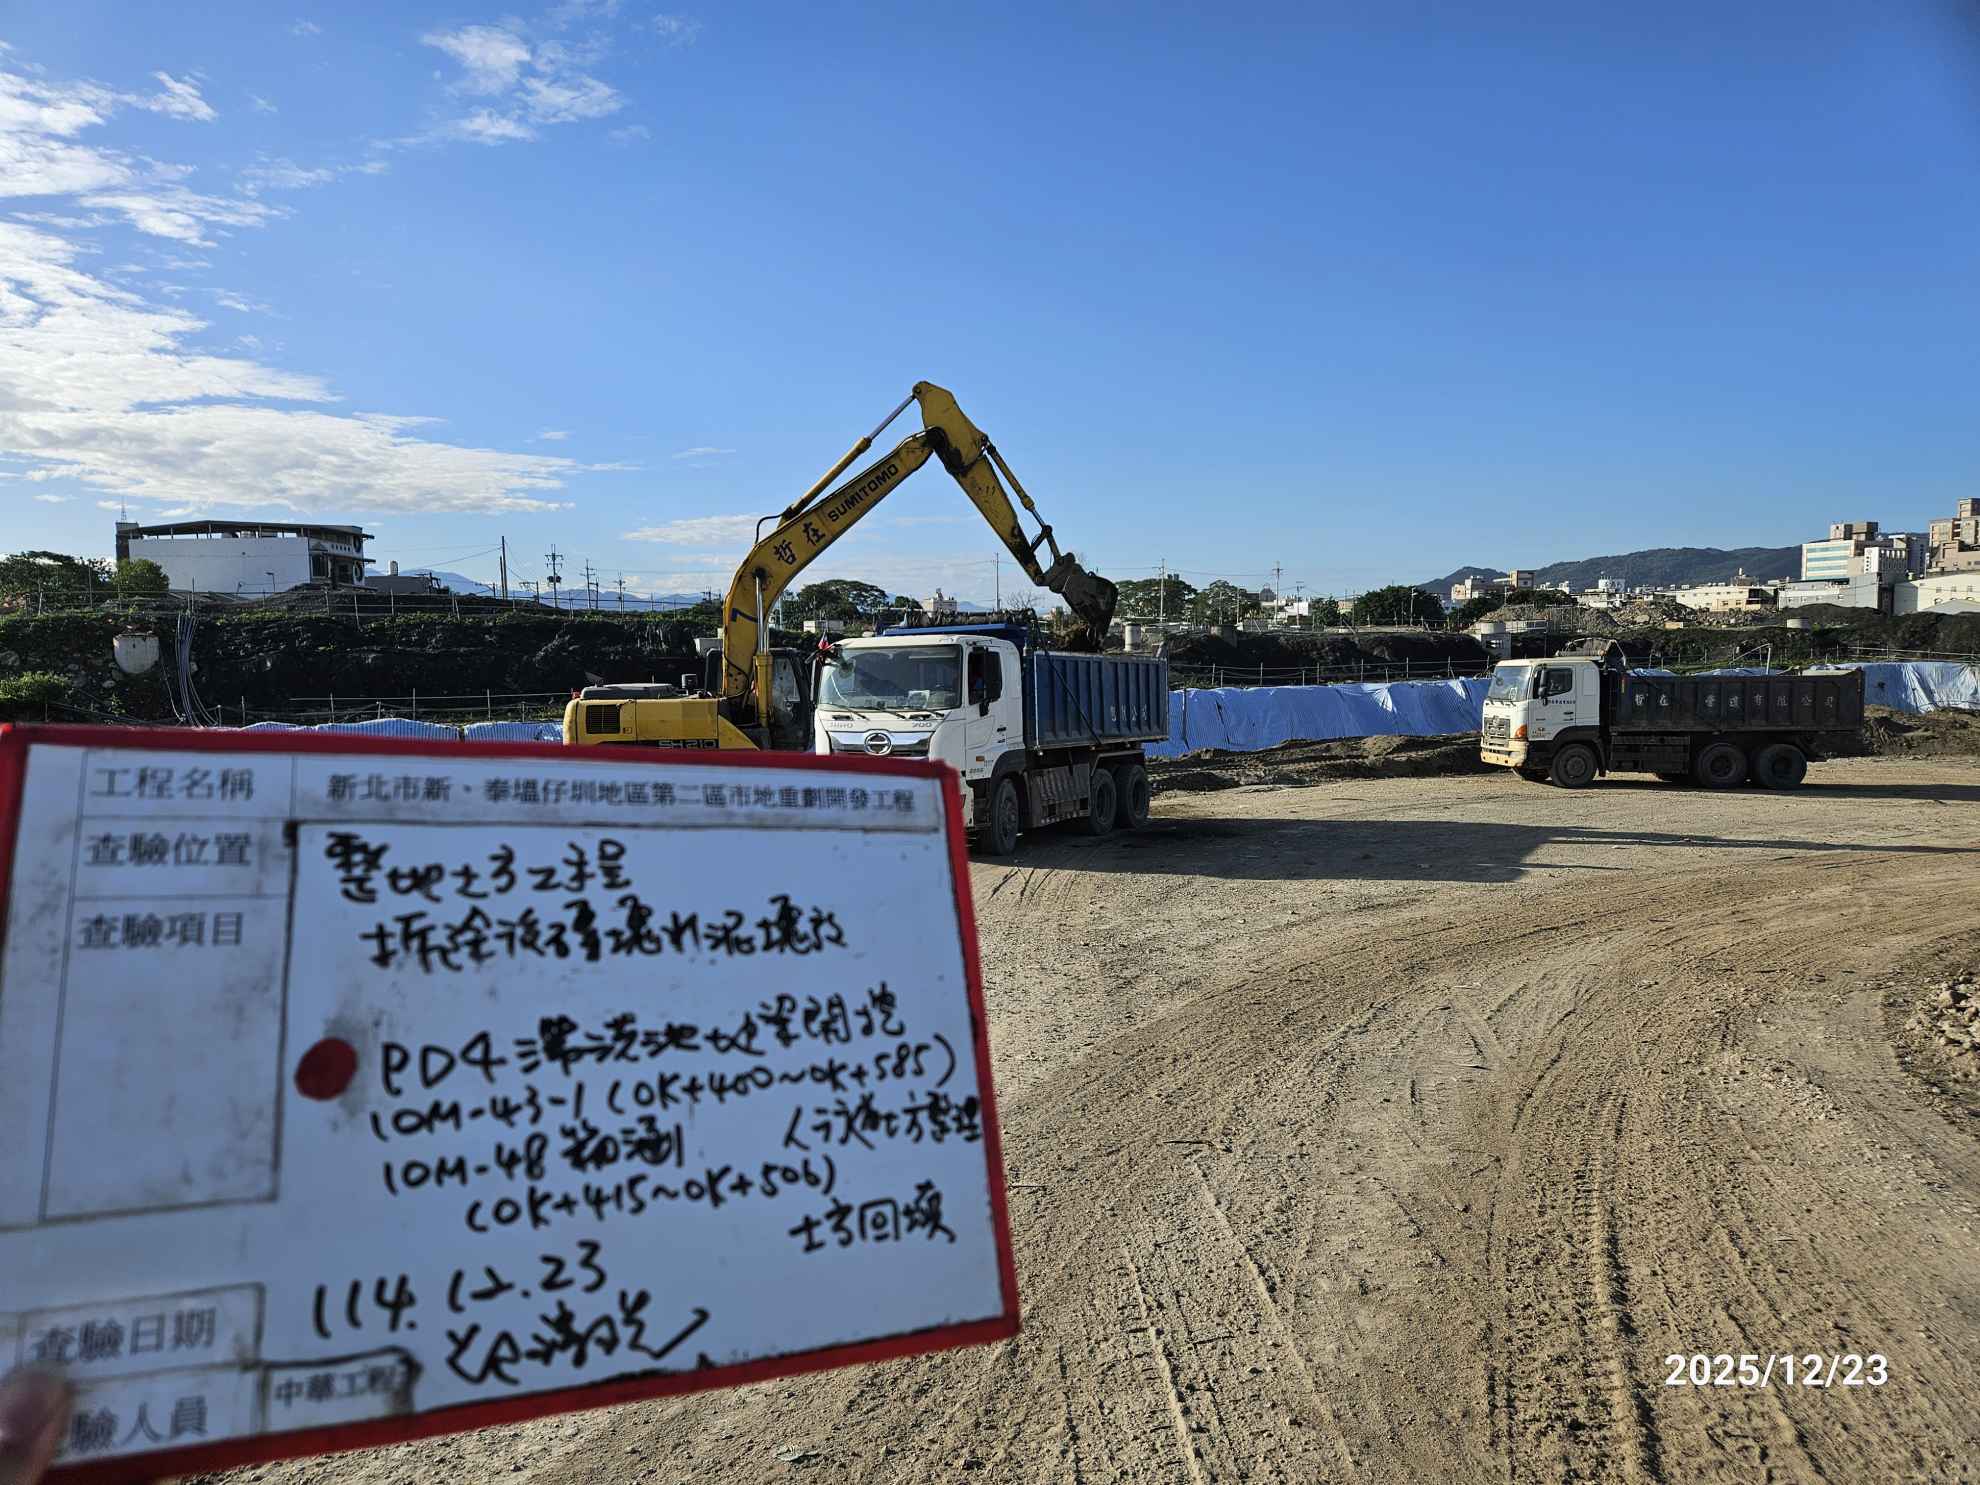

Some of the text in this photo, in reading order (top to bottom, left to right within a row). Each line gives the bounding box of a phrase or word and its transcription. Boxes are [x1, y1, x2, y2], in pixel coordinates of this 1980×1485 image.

[827, 462, 899, 522] SUMITOMO
[92, 767, 254, 800] 工程名稱
[84, 832, 252, 867] 查驗位置
[78, 912, 243, 950] 查驗項目
[70, 1396, 208, 1452] 驗人員
